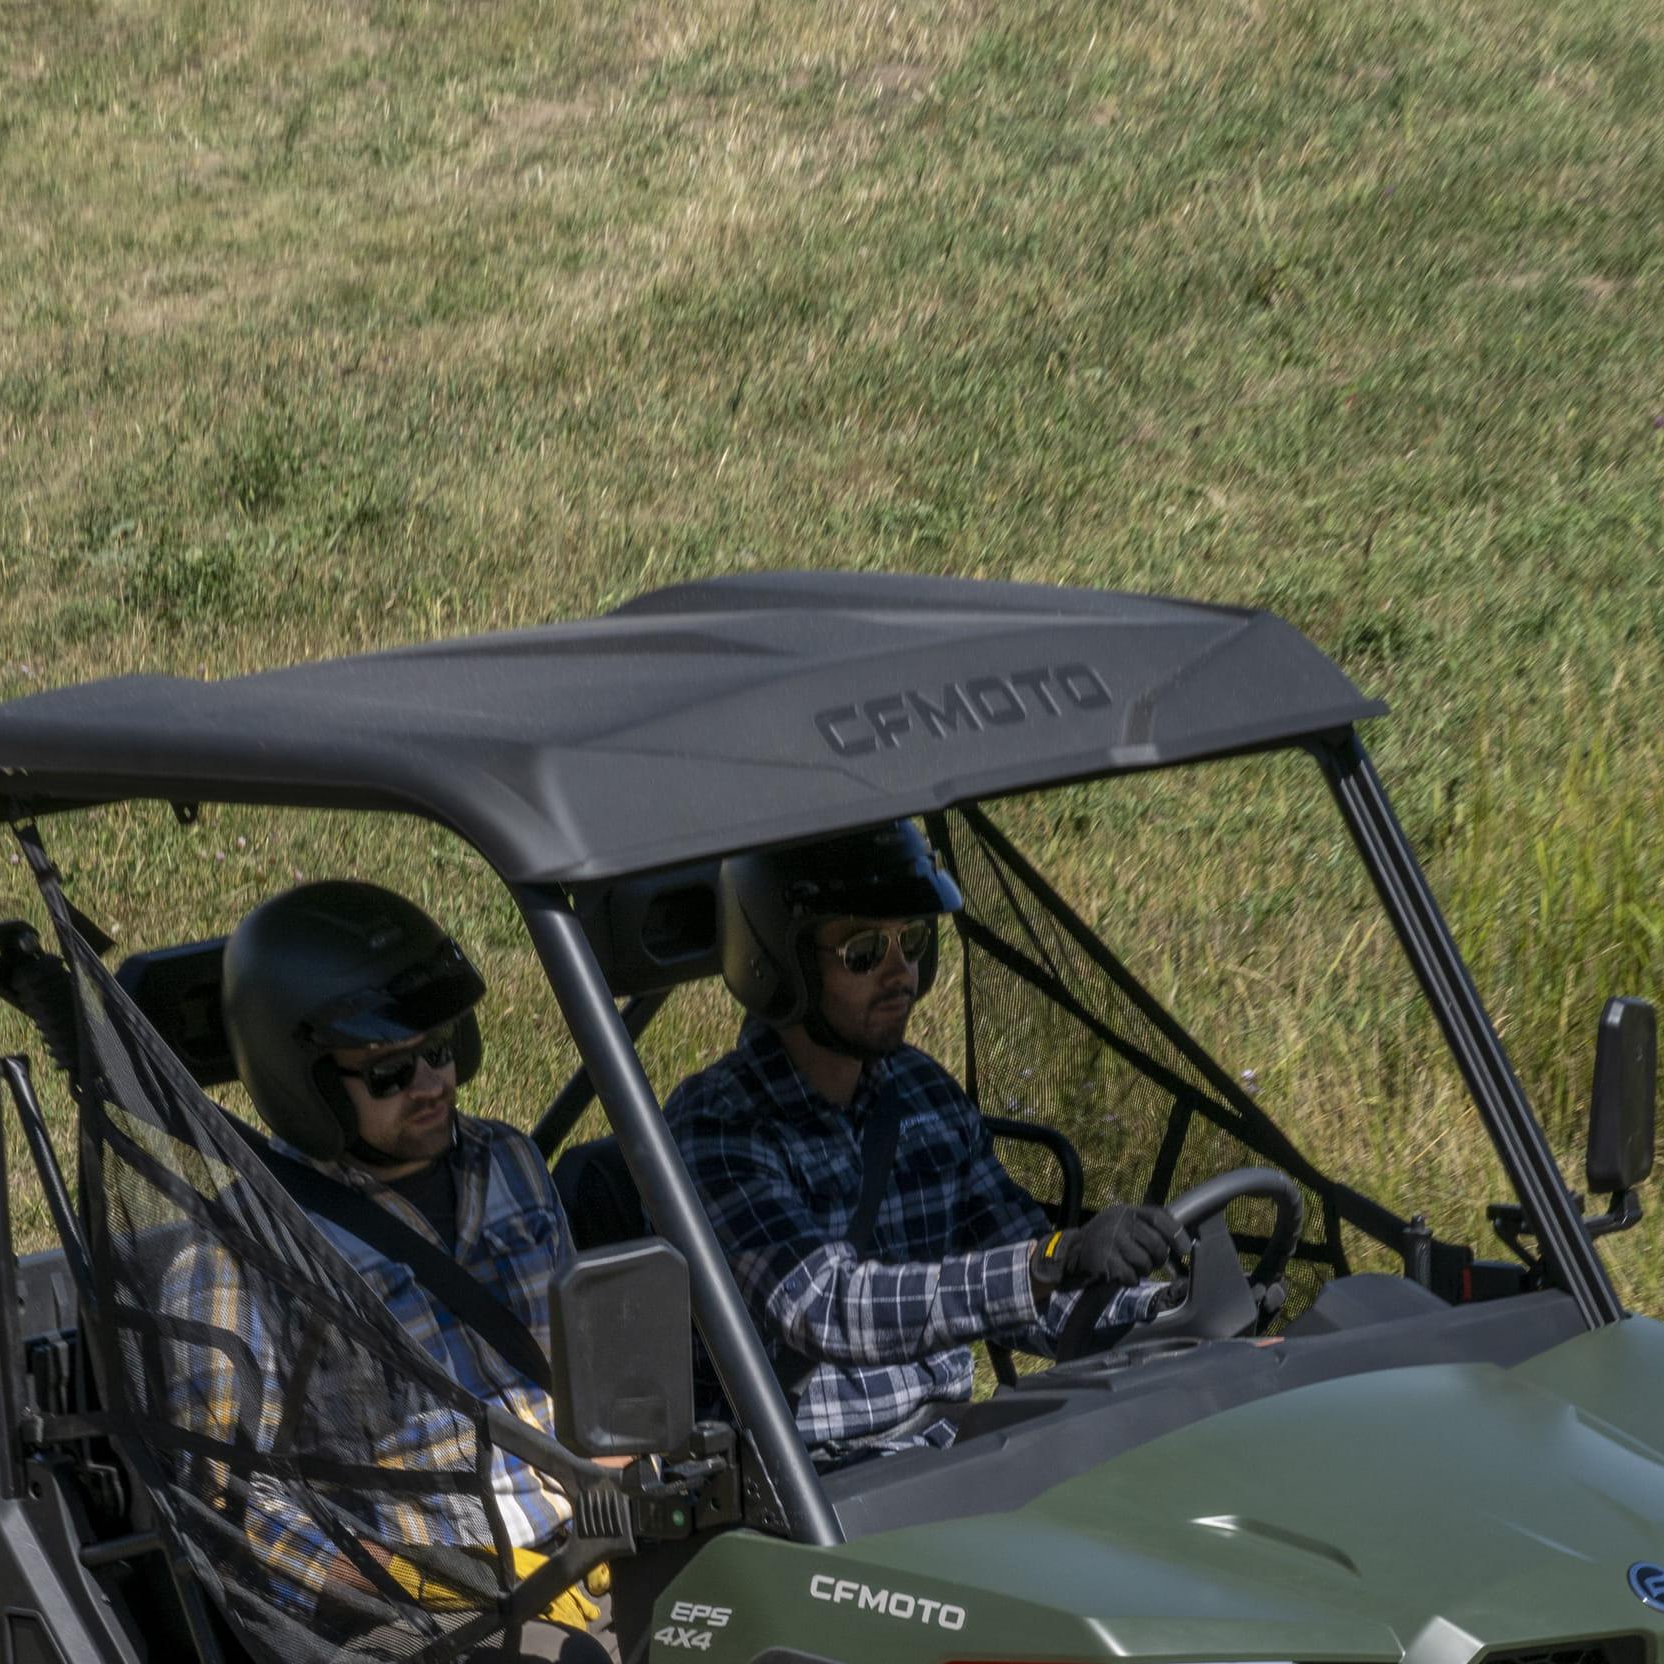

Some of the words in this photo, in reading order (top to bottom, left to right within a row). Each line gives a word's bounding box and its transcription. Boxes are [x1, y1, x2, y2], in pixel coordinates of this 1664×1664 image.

[814, 662, 1113, 757] CFMOTO
[670, 1600, 733, 1627] EPS
[810, 1573, 967, 1631] CFMOTO
[654, 1626, 713, 1651] 4X4
